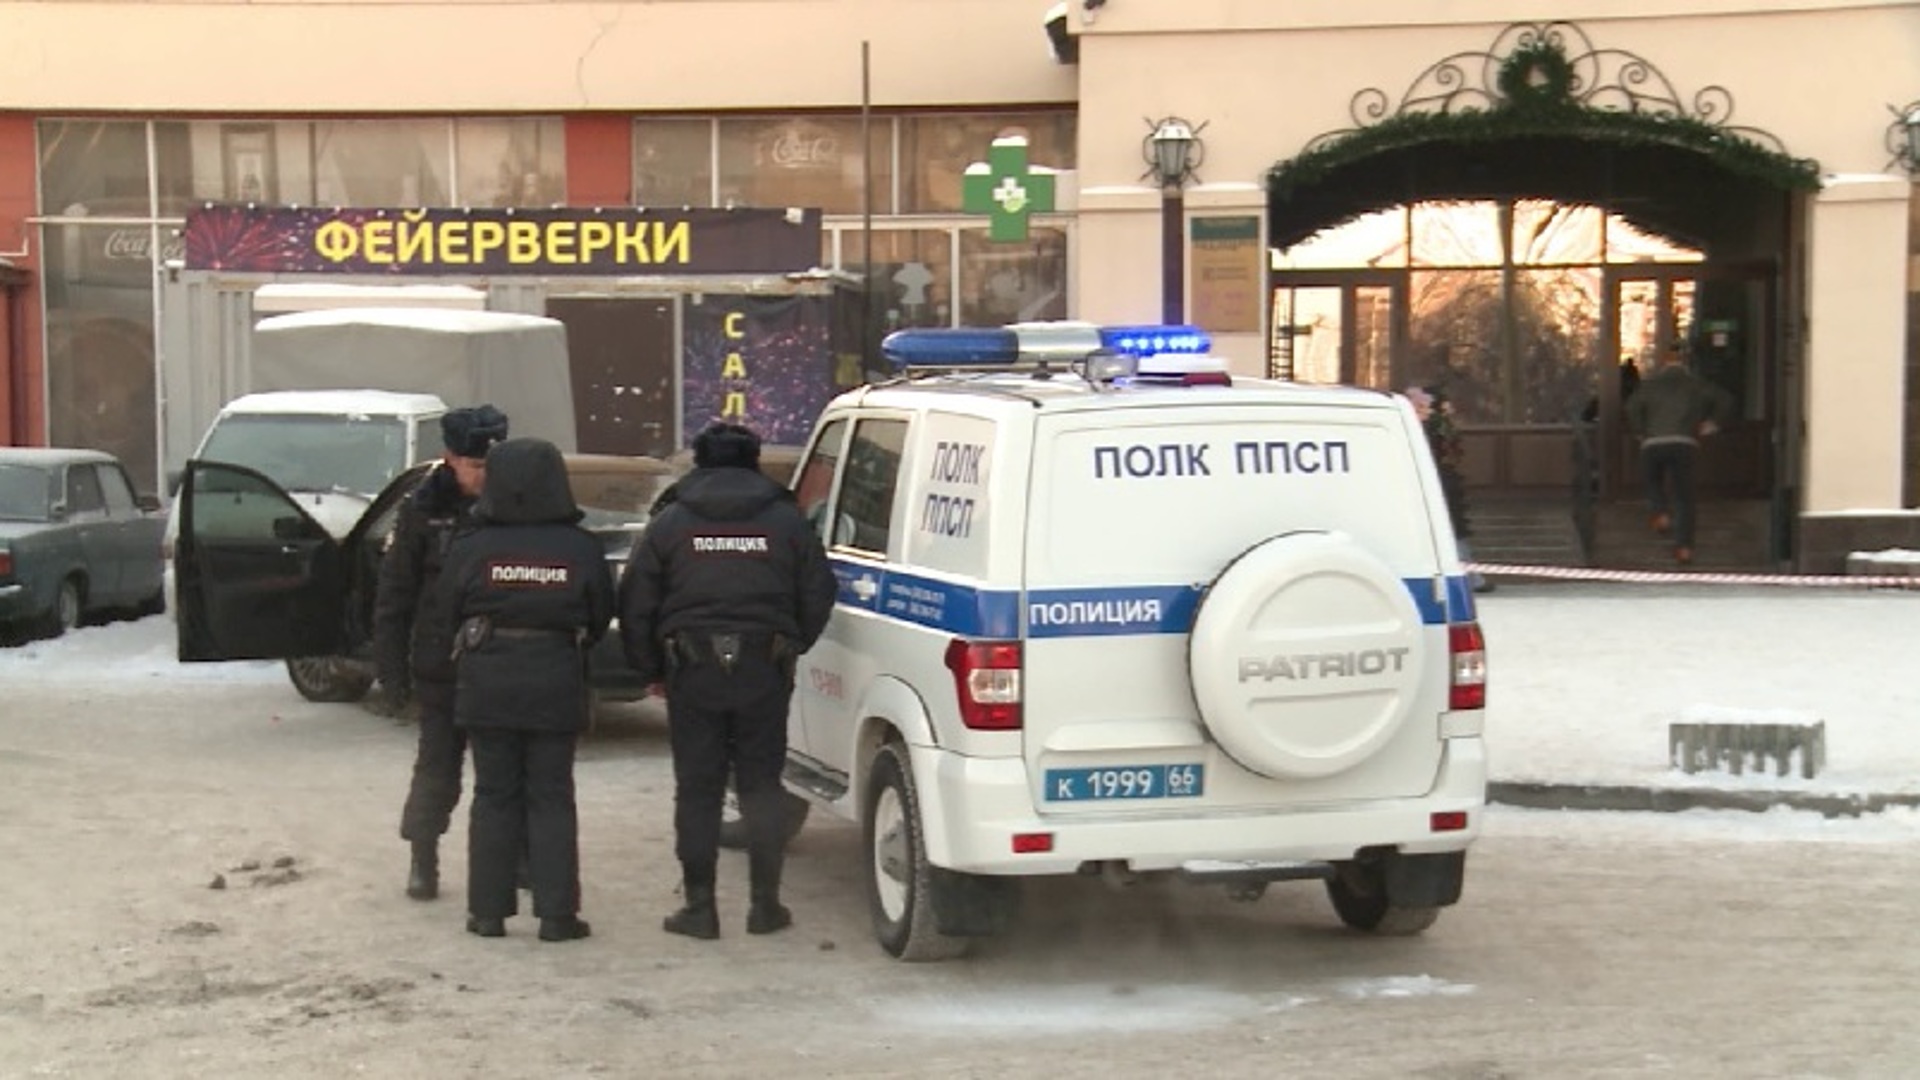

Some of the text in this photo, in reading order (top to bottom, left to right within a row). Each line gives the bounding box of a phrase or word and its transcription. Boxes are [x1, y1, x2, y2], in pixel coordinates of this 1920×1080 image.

[315, 210, 690, 264] ФЕЙЕРВЕРКИ
[930, 441, 985, 485] ПОЛК
[1094, 441, 1350, 479] ПОЛК ППСП
[920, 493, 975, 539] ППСП
[691, 536, 769, 553] ПОЛИЦИЯ
[491, 565, 567, 584] ПОЛИЦИЯ
[1029, 599, 1162, 626] ПОЛИЦИЯ
[1237, 646, 1411, 683] PATRIOT
[1087, 769, 1153, 797] 1999
[1168, 766, 1195, 788] 66
